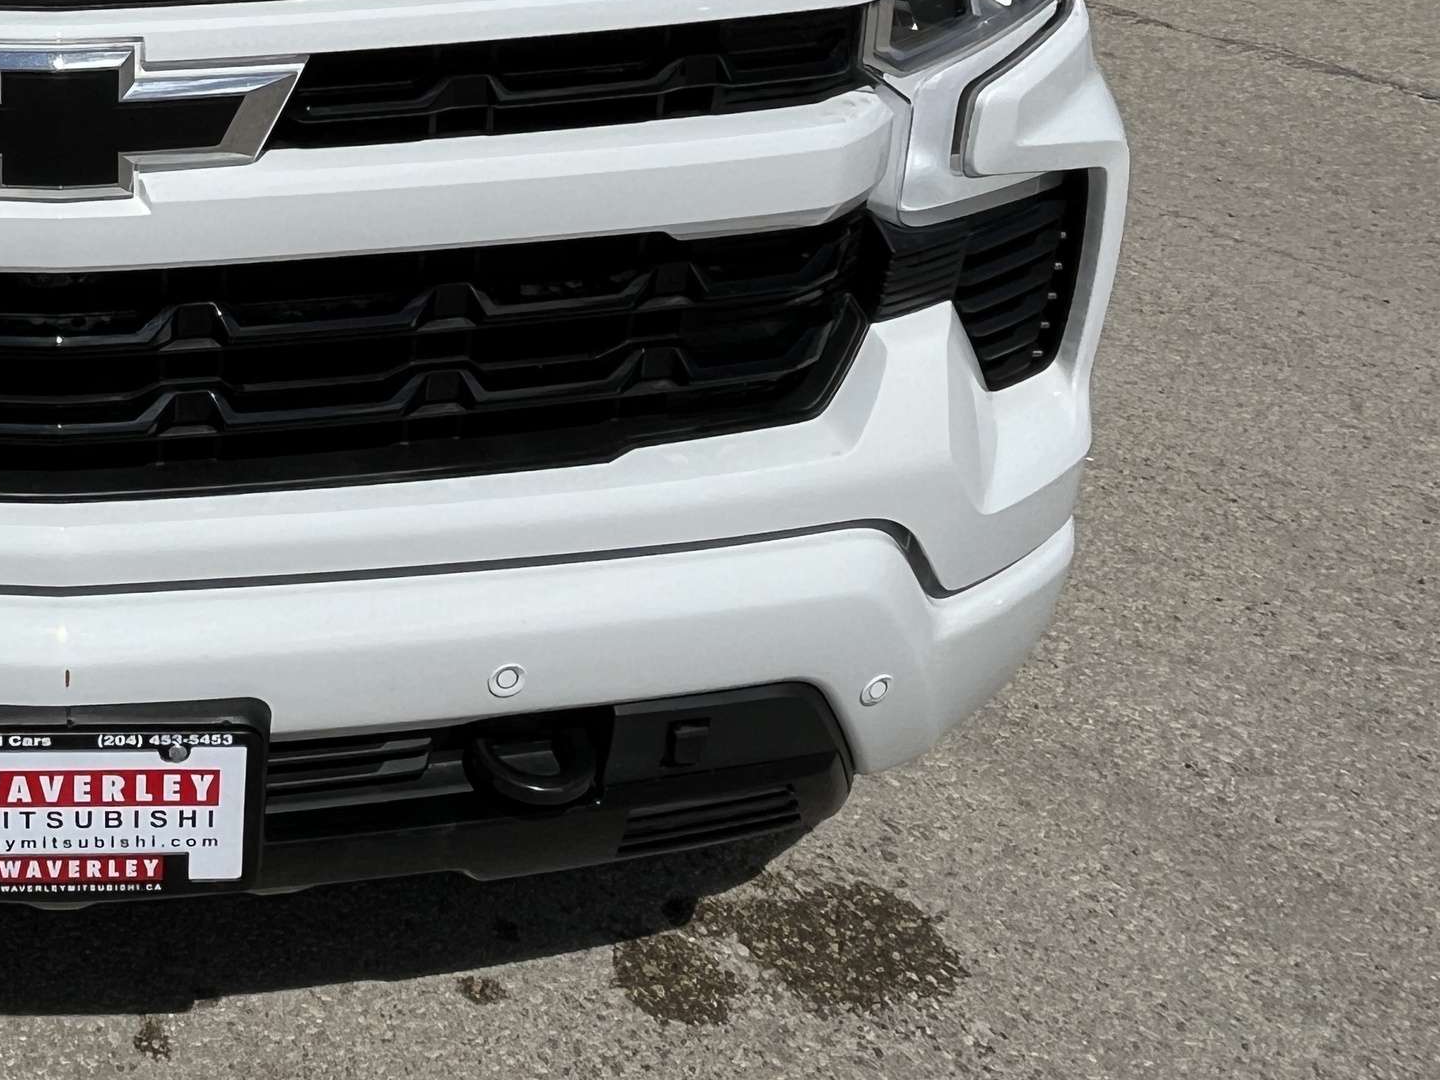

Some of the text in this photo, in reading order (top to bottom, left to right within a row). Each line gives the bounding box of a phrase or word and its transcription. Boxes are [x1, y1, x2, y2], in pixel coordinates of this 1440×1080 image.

[8, 735, 52, 747] Cars
[97, 734, 143, 748] (204)
[149, 734, 233, 747] 453-5453
